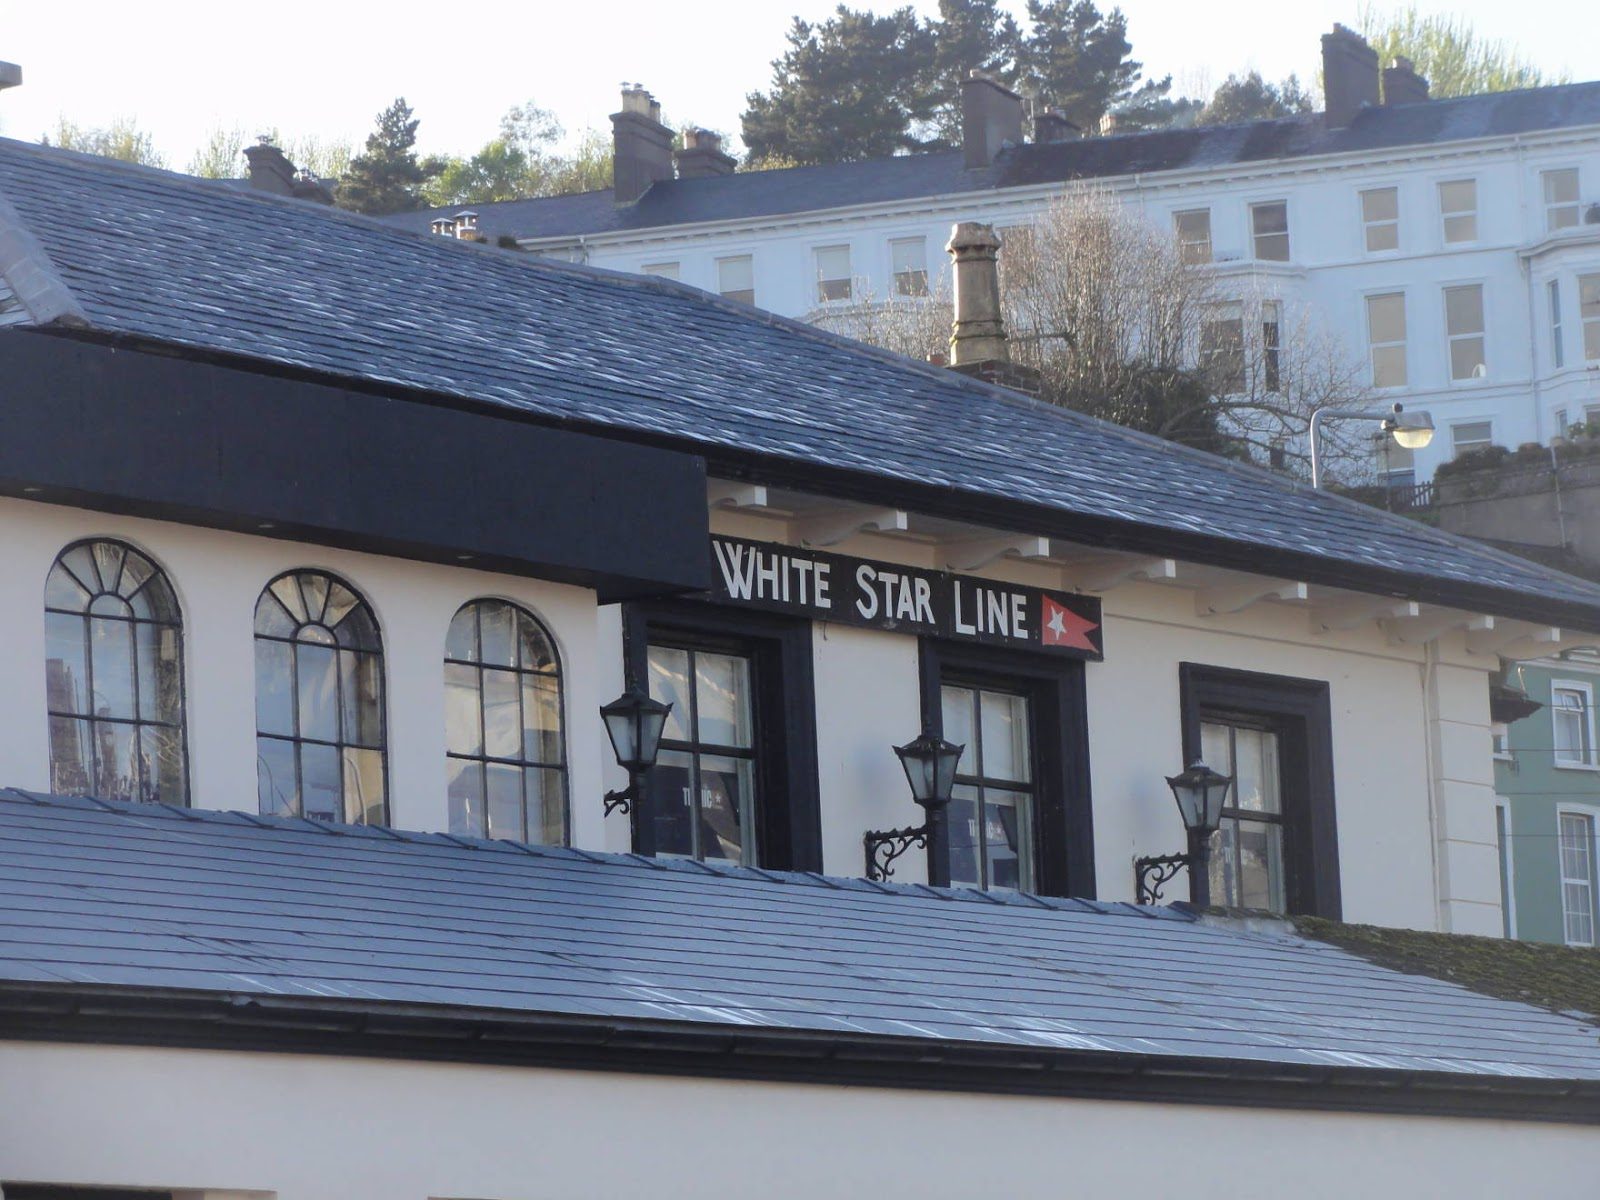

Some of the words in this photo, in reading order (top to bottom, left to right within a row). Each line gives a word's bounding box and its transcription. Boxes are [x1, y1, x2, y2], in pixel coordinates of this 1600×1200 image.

[712, 540, 831, 608] WHITE
[855, 565, 935, 624] STAR
[954, 580, 1028, 639] LINE
